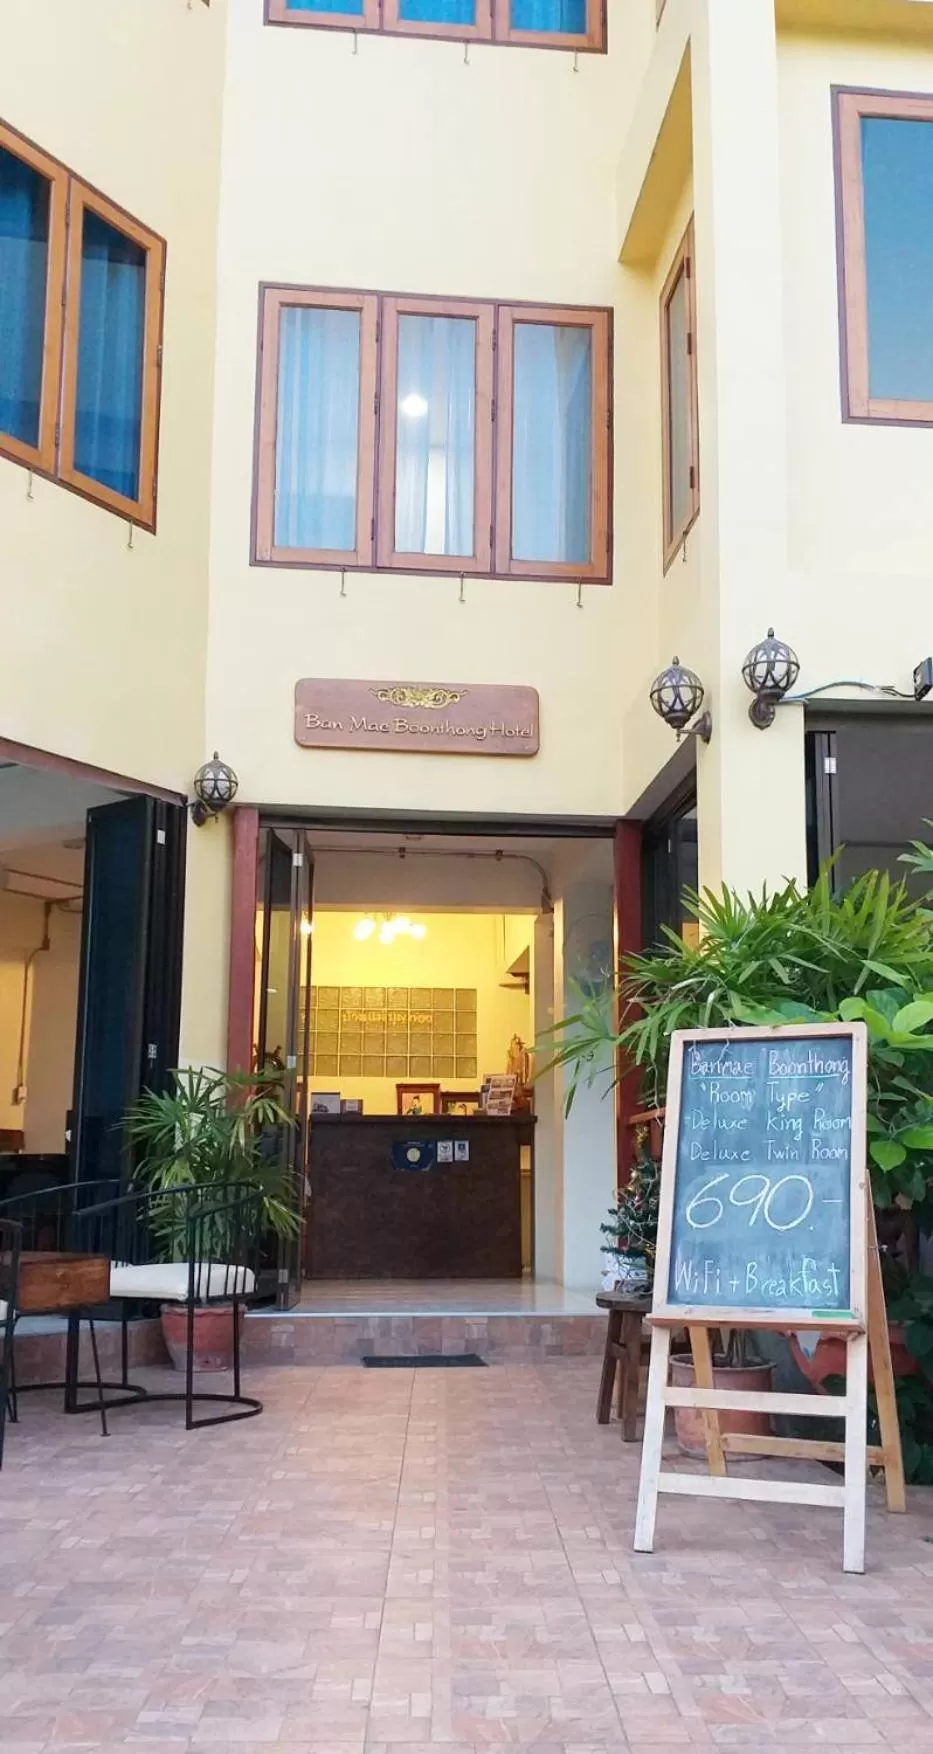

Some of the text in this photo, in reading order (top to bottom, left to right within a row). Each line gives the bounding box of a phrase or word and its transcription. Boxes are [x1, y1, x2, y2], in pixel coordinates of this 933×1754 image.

[304, 713, 535, 741] Ban Mae Boonthong Hotel
[767, 1049, 851, 1085] Boonthong
[763, 1139, 799, 1162] Twin
